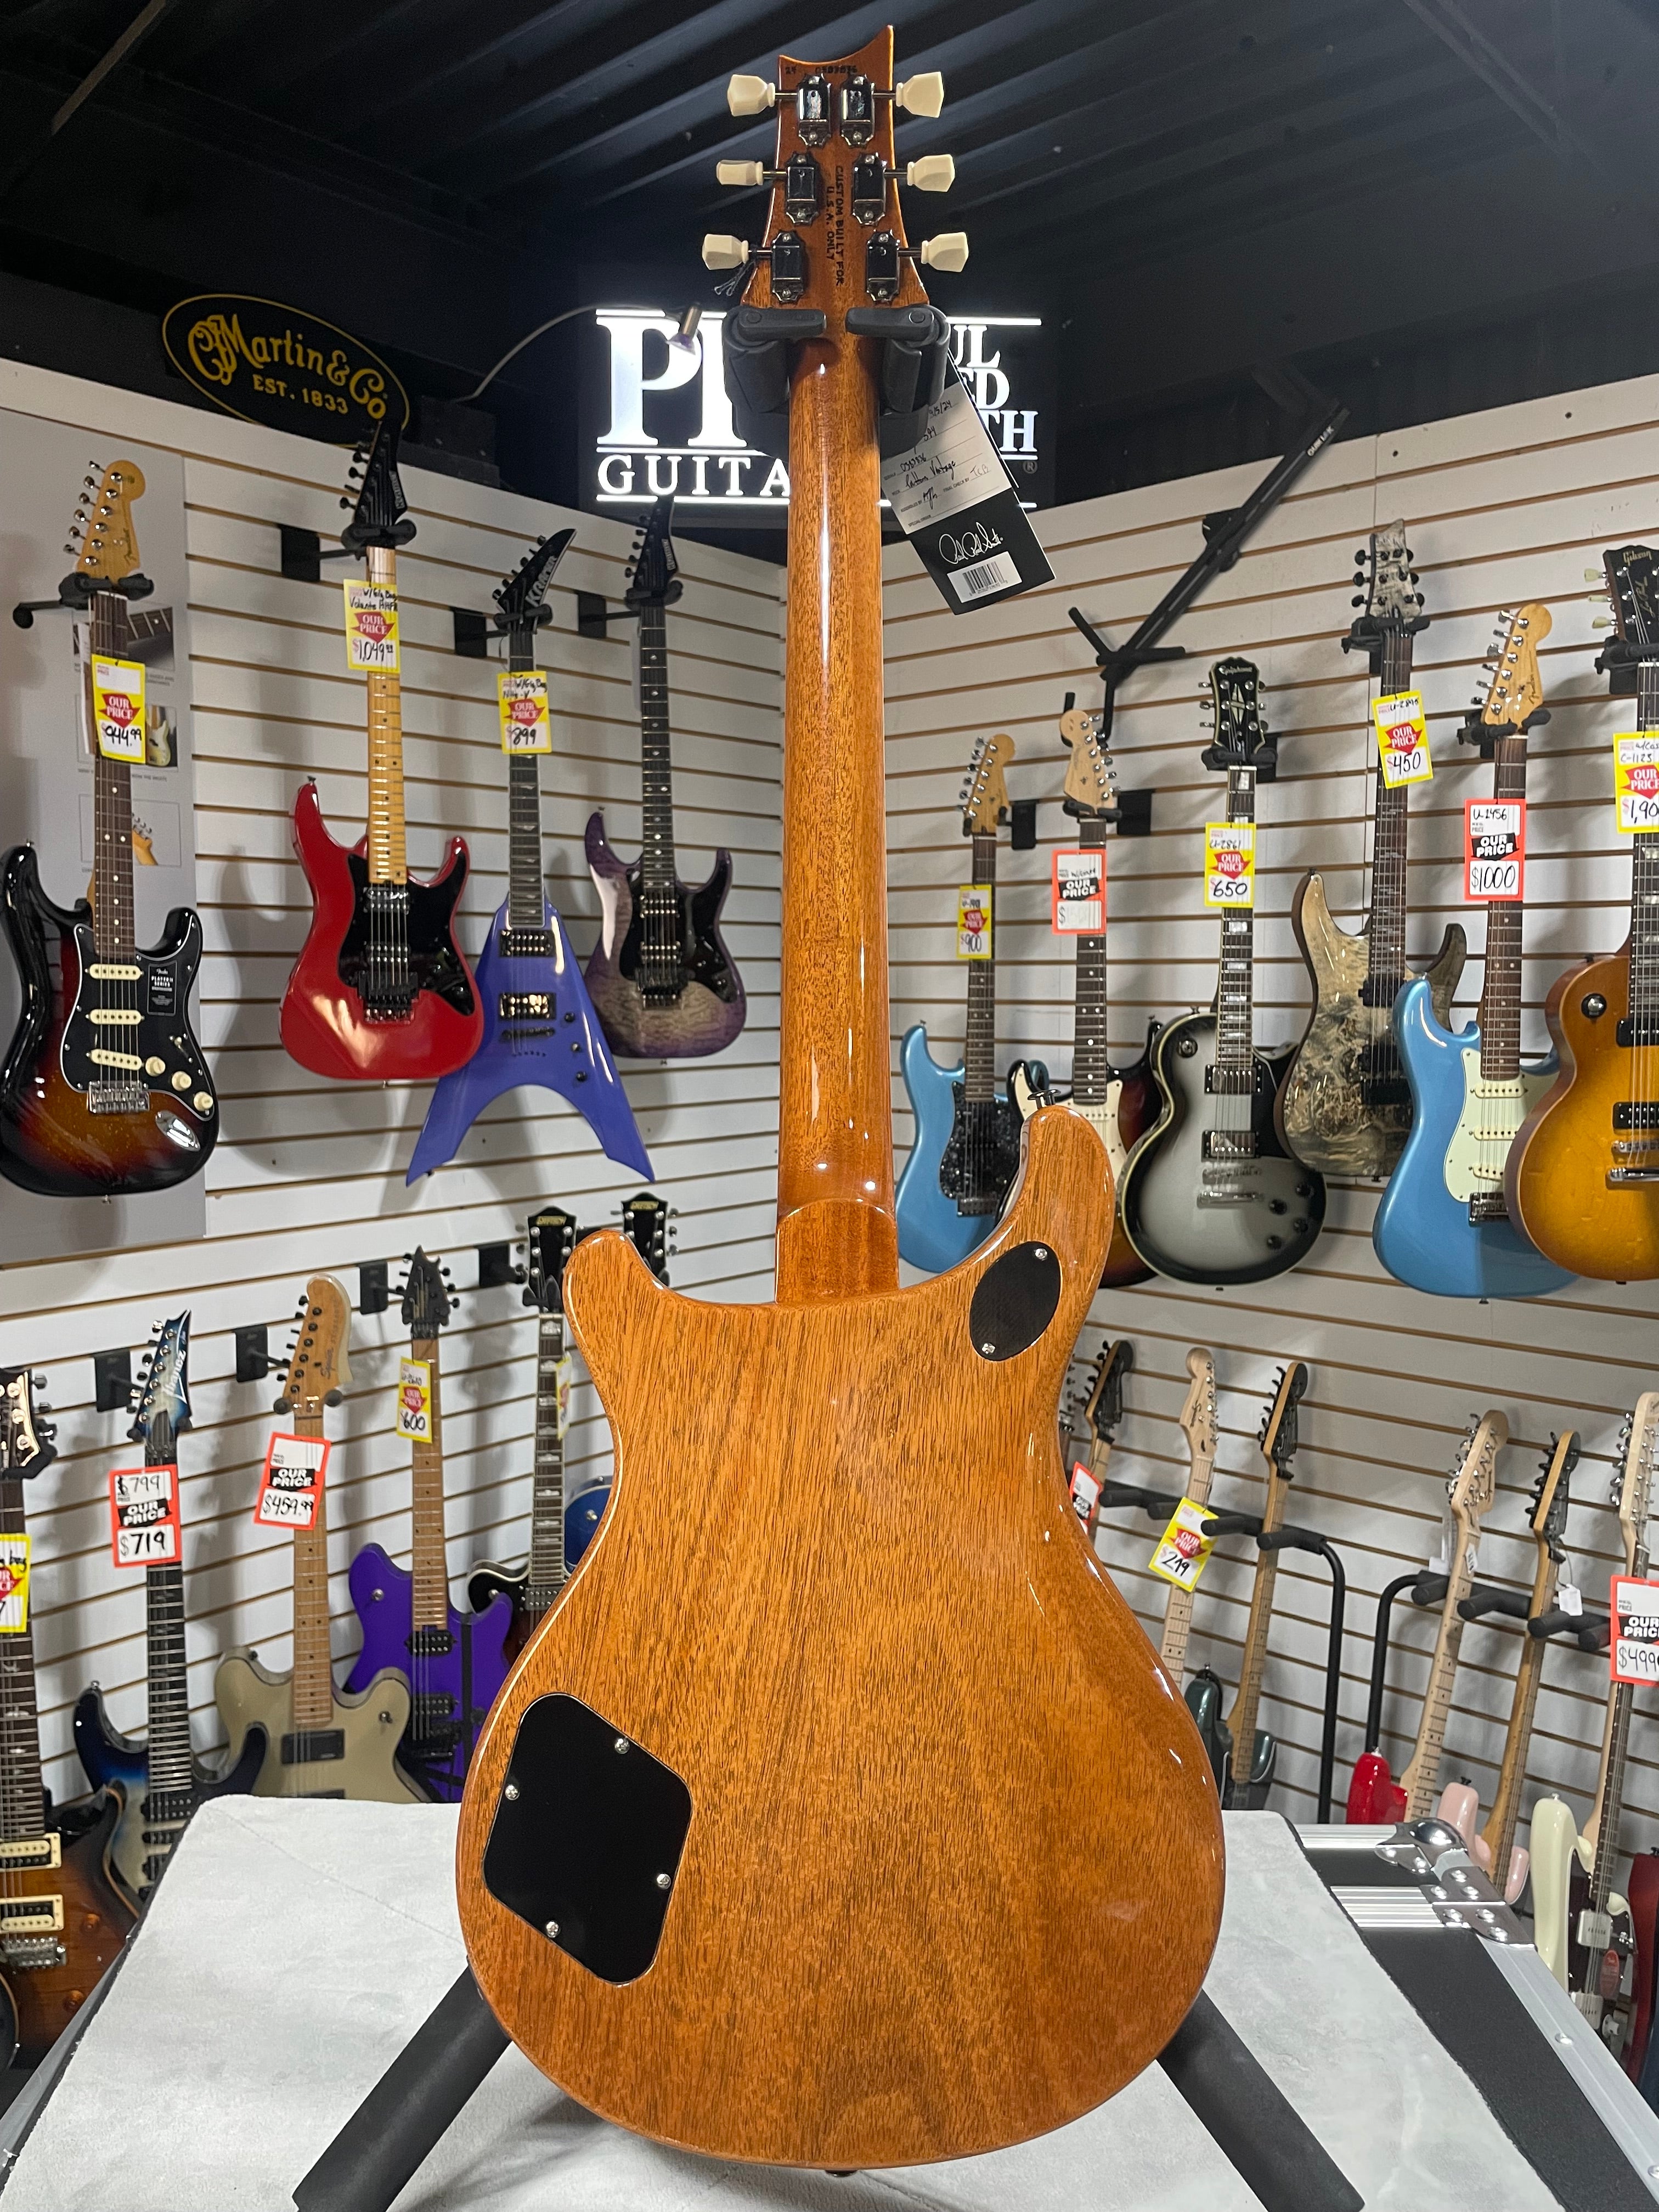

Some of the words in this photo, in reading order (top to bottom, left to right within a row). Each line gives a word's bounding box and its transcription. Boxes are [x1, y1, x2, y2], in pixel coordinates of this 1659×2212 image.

[836, 165, 844, 215] CUSTOM
[827, 231, 835, 260] ONLY
[836, 219, 844, 257] BUILT
[836, 261, 844, 286] FOR
[252, 374, 296, 400] EST.
[302, 388, 348, 415] 1833
[1622, 550, 1652, 567] Gibson
[362, 614, 384, 625] OUR
[359, 623, 387, 635] PRICE
[108, 695, 129, 709] OUR
[514, 702, 535, 711] OUR
[106, 707, 134, 720] PRICE
[512, 710, 539, 720] PRICE
[1392, 725, 1413, 738] OUR
[1391, 733, 1418, 749] PRICE
[1633, 768, 1657, 780] OUR
[1480, 834, 1508, 847] OUR
[1476, 842, 1514, 857] PRICE
[1221, 853, 1242, 864] OUR
[1218, 861, 1244, 872] PRICE
[1065, 879, 1091, 890] OUR
[1471, 865, 1516, 893] $1000
[1062, 884, 1097, 899] PRICE
[162, 1350, 187, 1395] Ibanez
[278, 1468, 308, 1479] OUR
[272, 1477, 313, 1488] PRICE
[127, 1500, 159, 1516] OUR
[123, 1506, 167, 1527] PRICE
[119, 1531, 166, 1558] $719
[1174, 1537, 1200, 1556] PRICE
[1180, 1531, 1200, 1547] OUR
[1628, 1616, 1659, 1628] OUR
[1623, 1626, 1659, 1638] PRIC
[1618, 1645, 1659, 1673] $499
